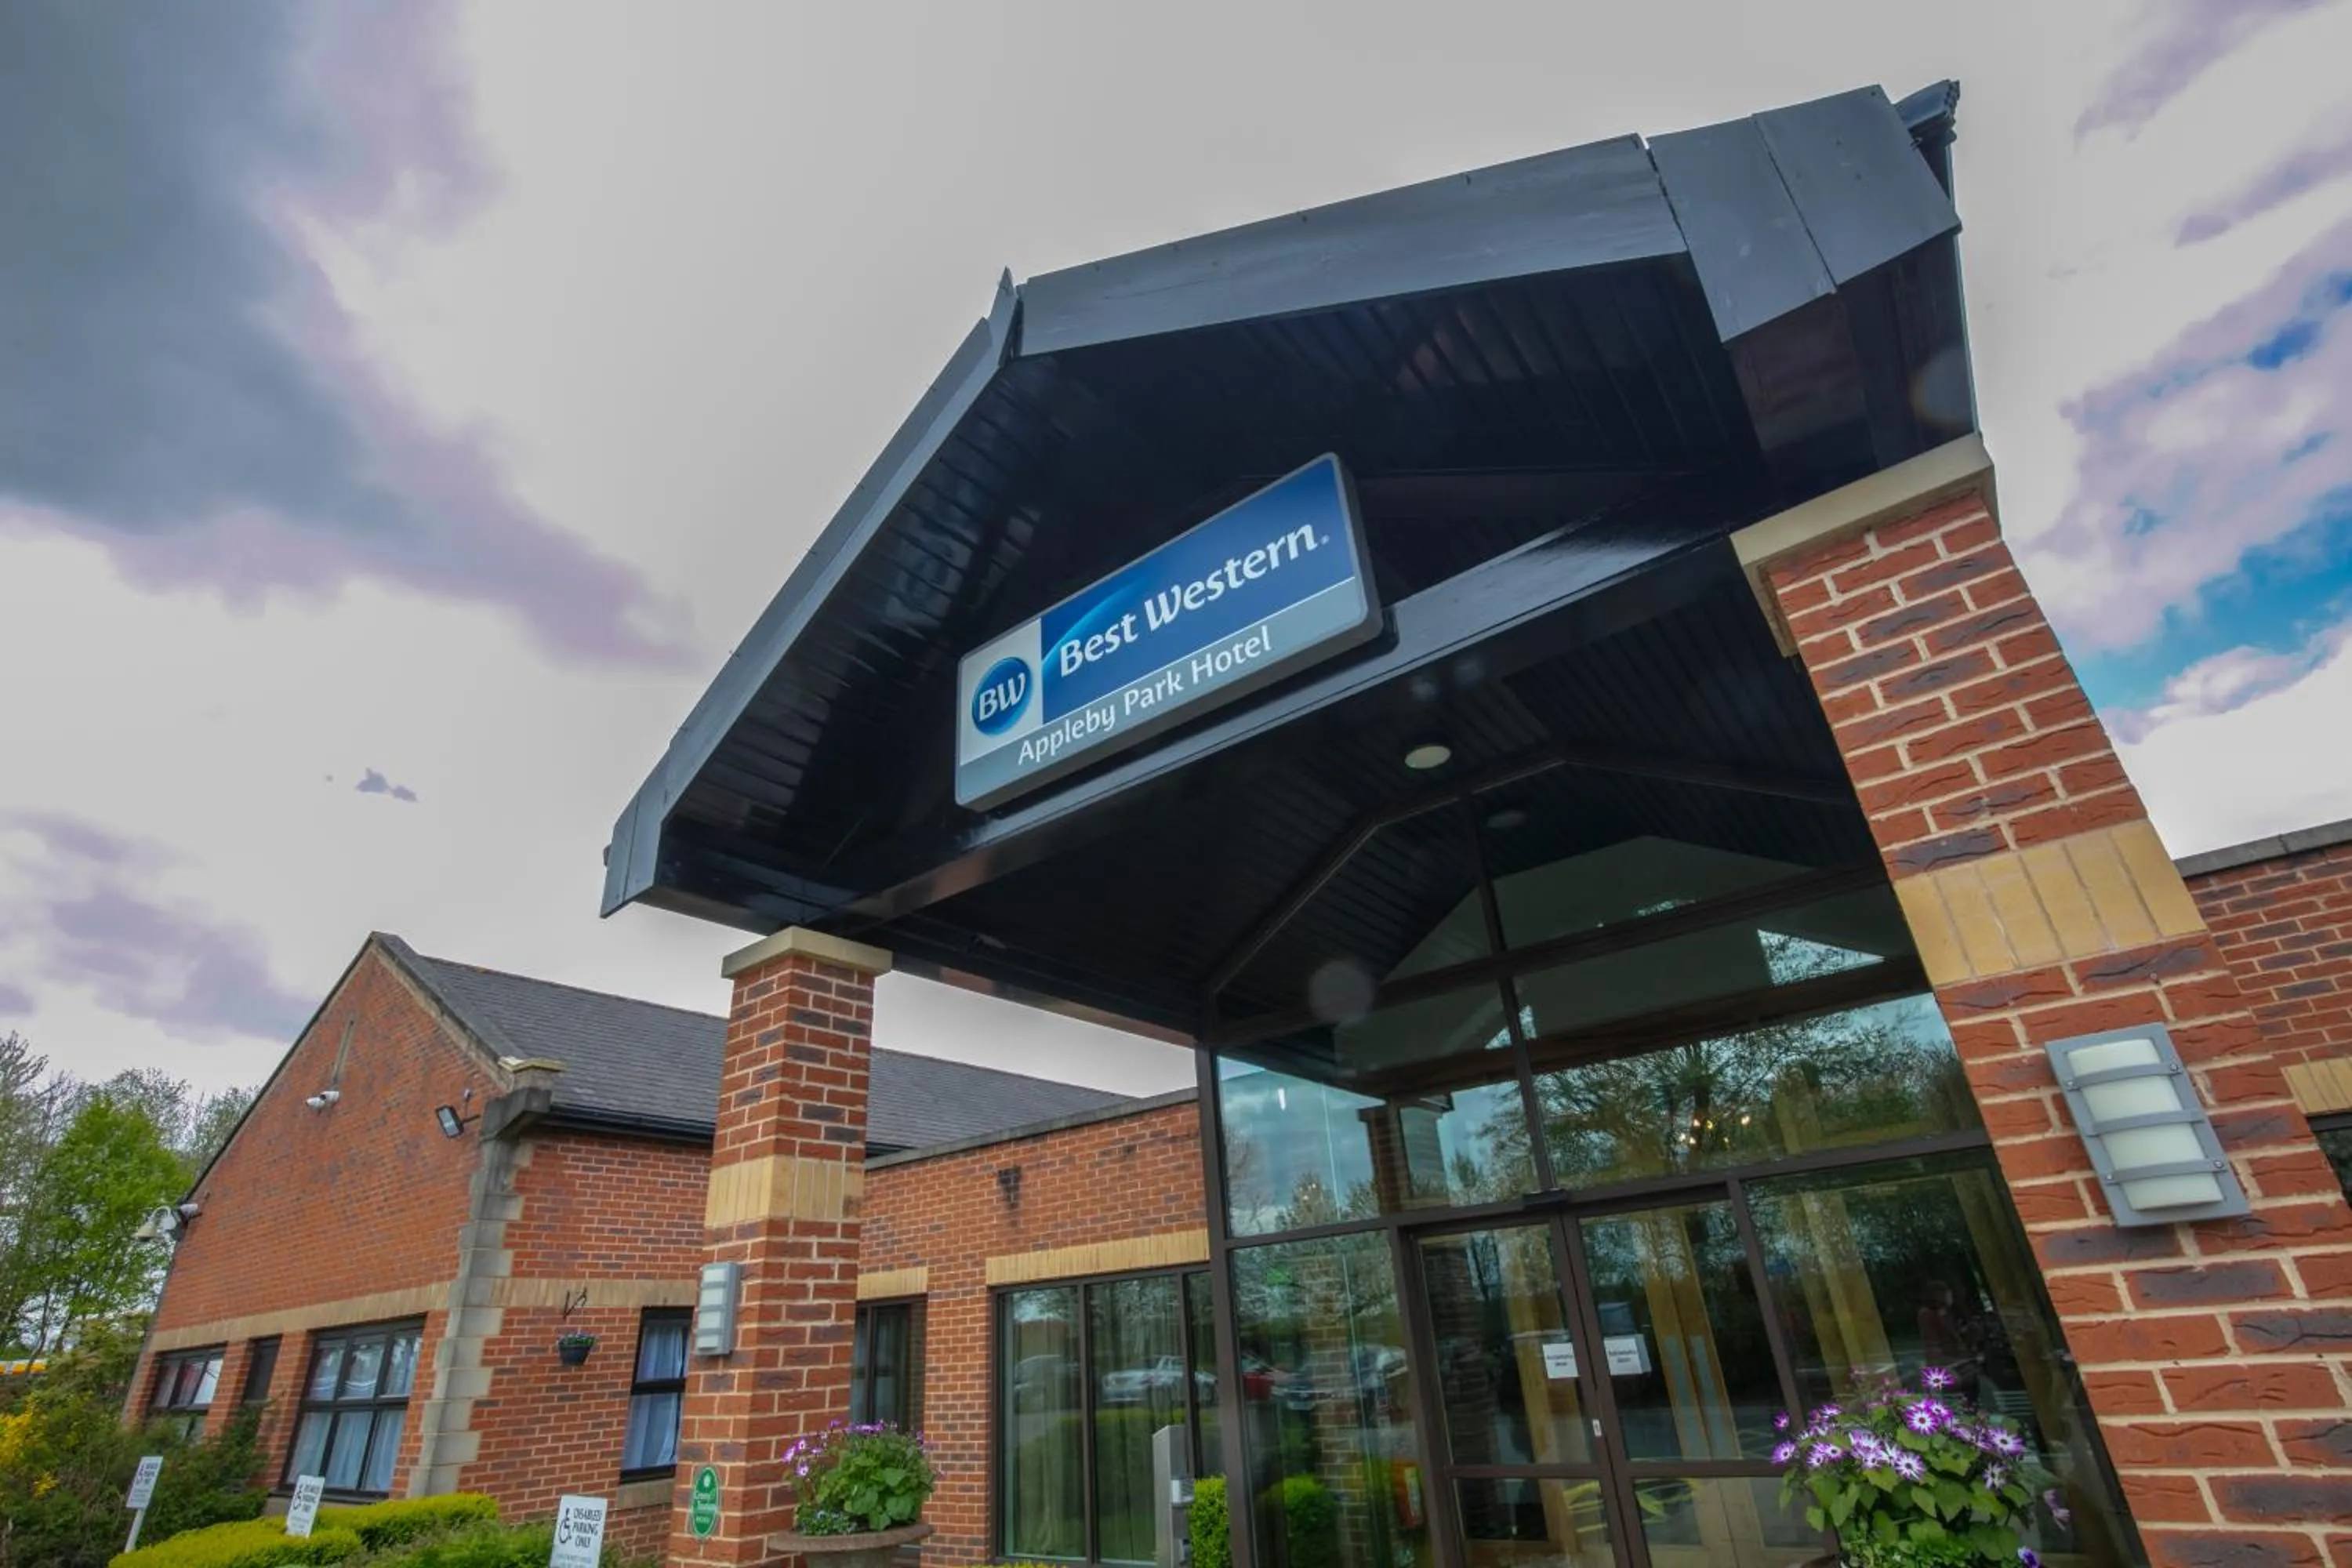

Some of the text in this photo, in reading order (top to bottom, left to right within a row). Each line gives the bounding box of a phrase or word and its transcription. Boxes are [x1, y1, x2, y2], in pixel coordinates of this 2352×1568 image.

[1060, 611, 1139, 678] Best
[978, 672, 1027, 723] BW
[1017, 624, 1273, 766] Appleby Park Hotel
[572, 1521, 600, 1537] PARKING
[573, 1507, 603, 1522] DISABLED
[575, 1535, 592, 1548] ONLY
